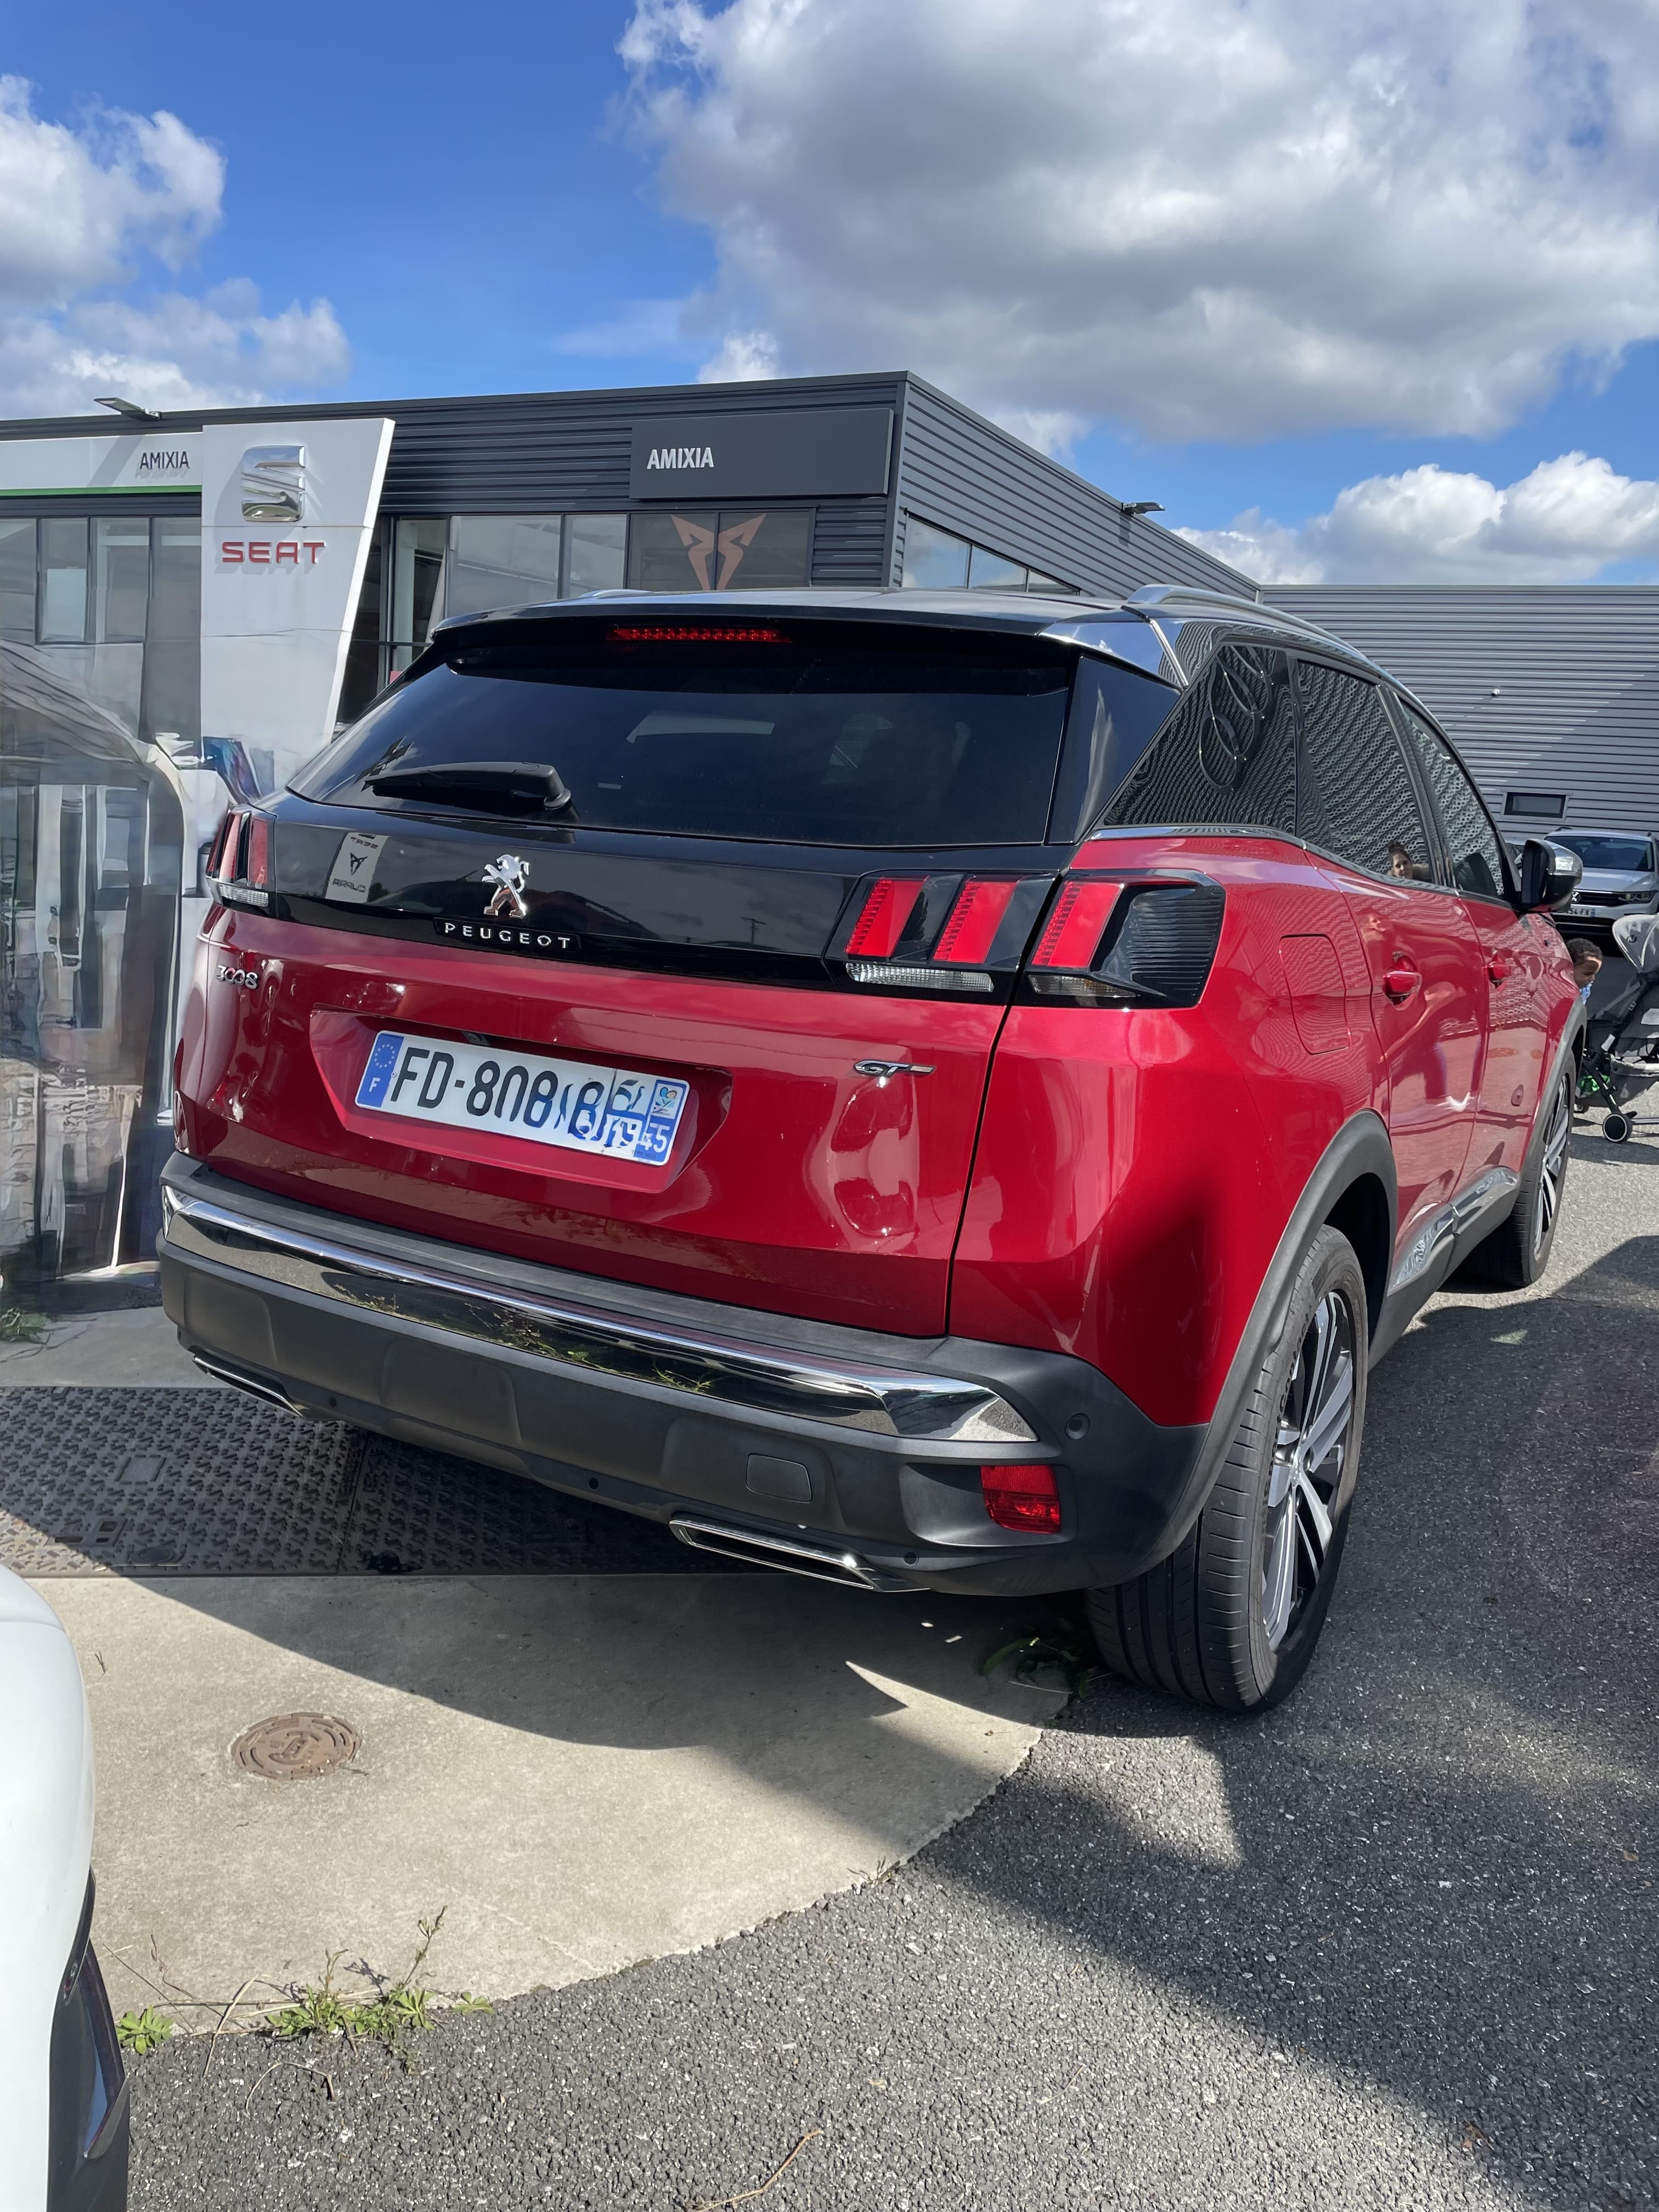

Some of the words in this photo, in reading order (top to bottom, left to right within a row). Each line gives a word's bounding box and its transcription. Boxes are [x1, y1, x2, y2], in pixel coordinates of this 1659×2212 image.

[140, 451, 190, 470] AMIXIA
[646, 447, 714, 470] AMIXIA
[222, 541, 326, 564] SEAT
[445, 922, 571, 949] PEUGEOT
[215, 965, 258, 989] 3008
[855, 1060, 910, 1076] GT
[369, 1077, 381, 1092] F
